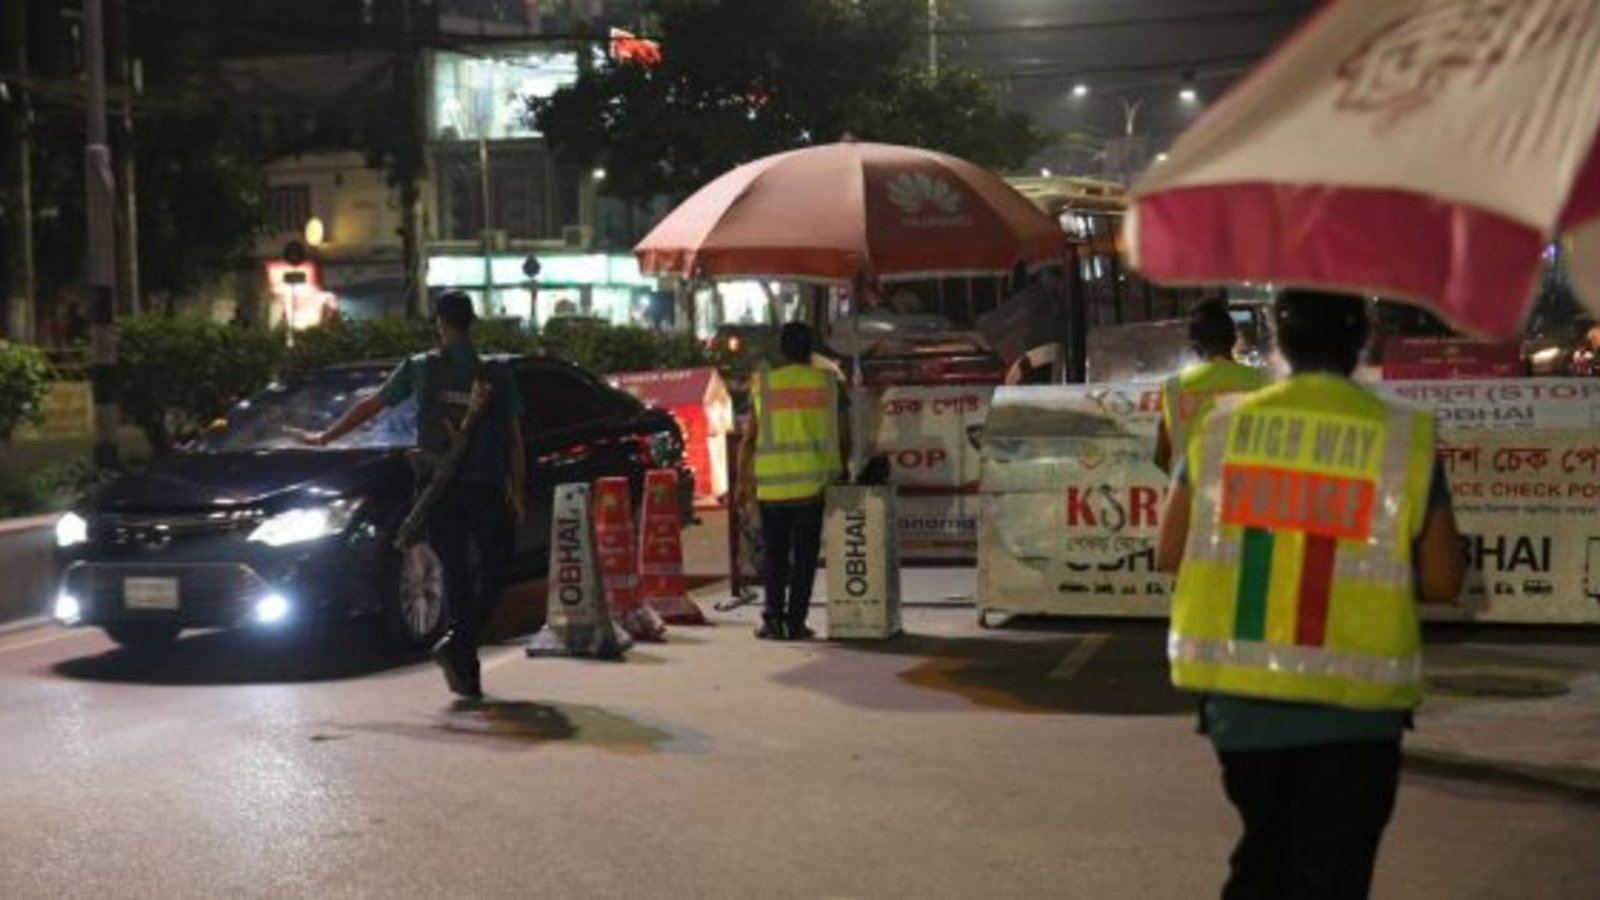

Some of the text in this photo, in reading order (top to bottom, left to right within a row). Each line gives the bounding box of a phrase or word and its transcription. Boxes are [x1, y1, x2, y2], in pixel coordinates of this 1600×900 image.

[1233, 412, 1379, 467] HIGH WAY
[1067, 483, 1169, 532] KSR
[1225, 471, 1365, 532] POLICE
[1453, 482, 1485, 497] ICE
[1491, 482, 1560, 498] CHECK
[557, 519, 583, 606] OBHAI
[844, 511, 869, 597] OBHAI
